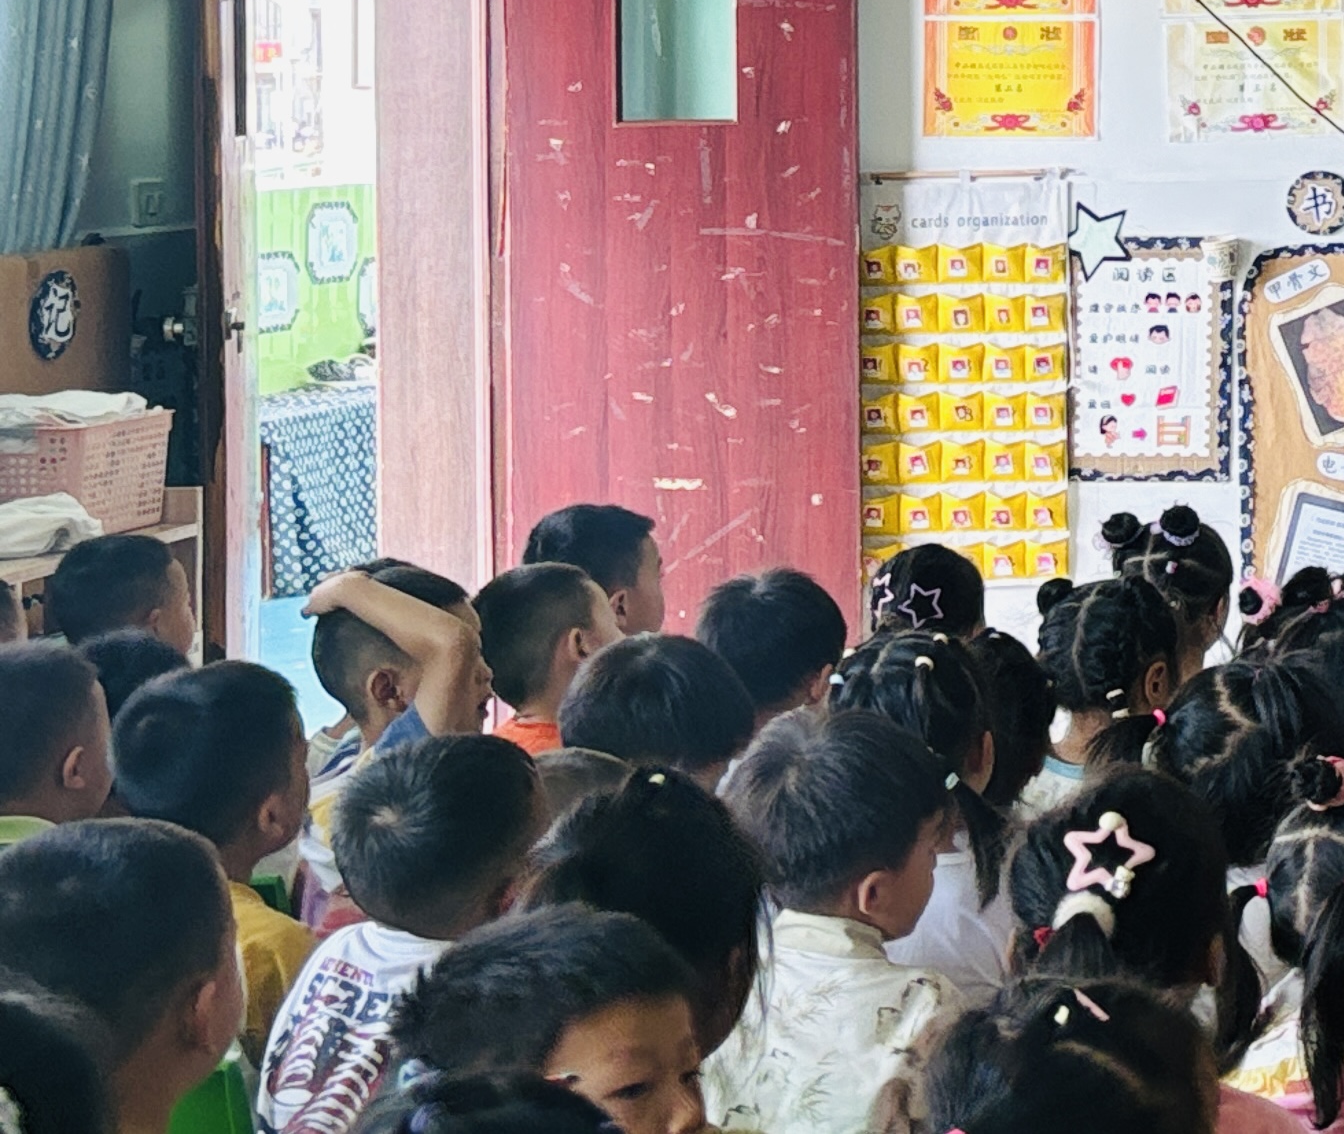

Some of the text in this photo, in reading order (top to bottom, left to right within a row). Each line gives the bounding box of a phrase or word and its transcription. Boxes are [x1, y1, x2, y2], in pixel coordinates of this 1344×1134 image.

[911, 212, 1048, 231] cards organization
[1302, 186, 1333, 224] 书
[44, 287, 71, 338] 记
